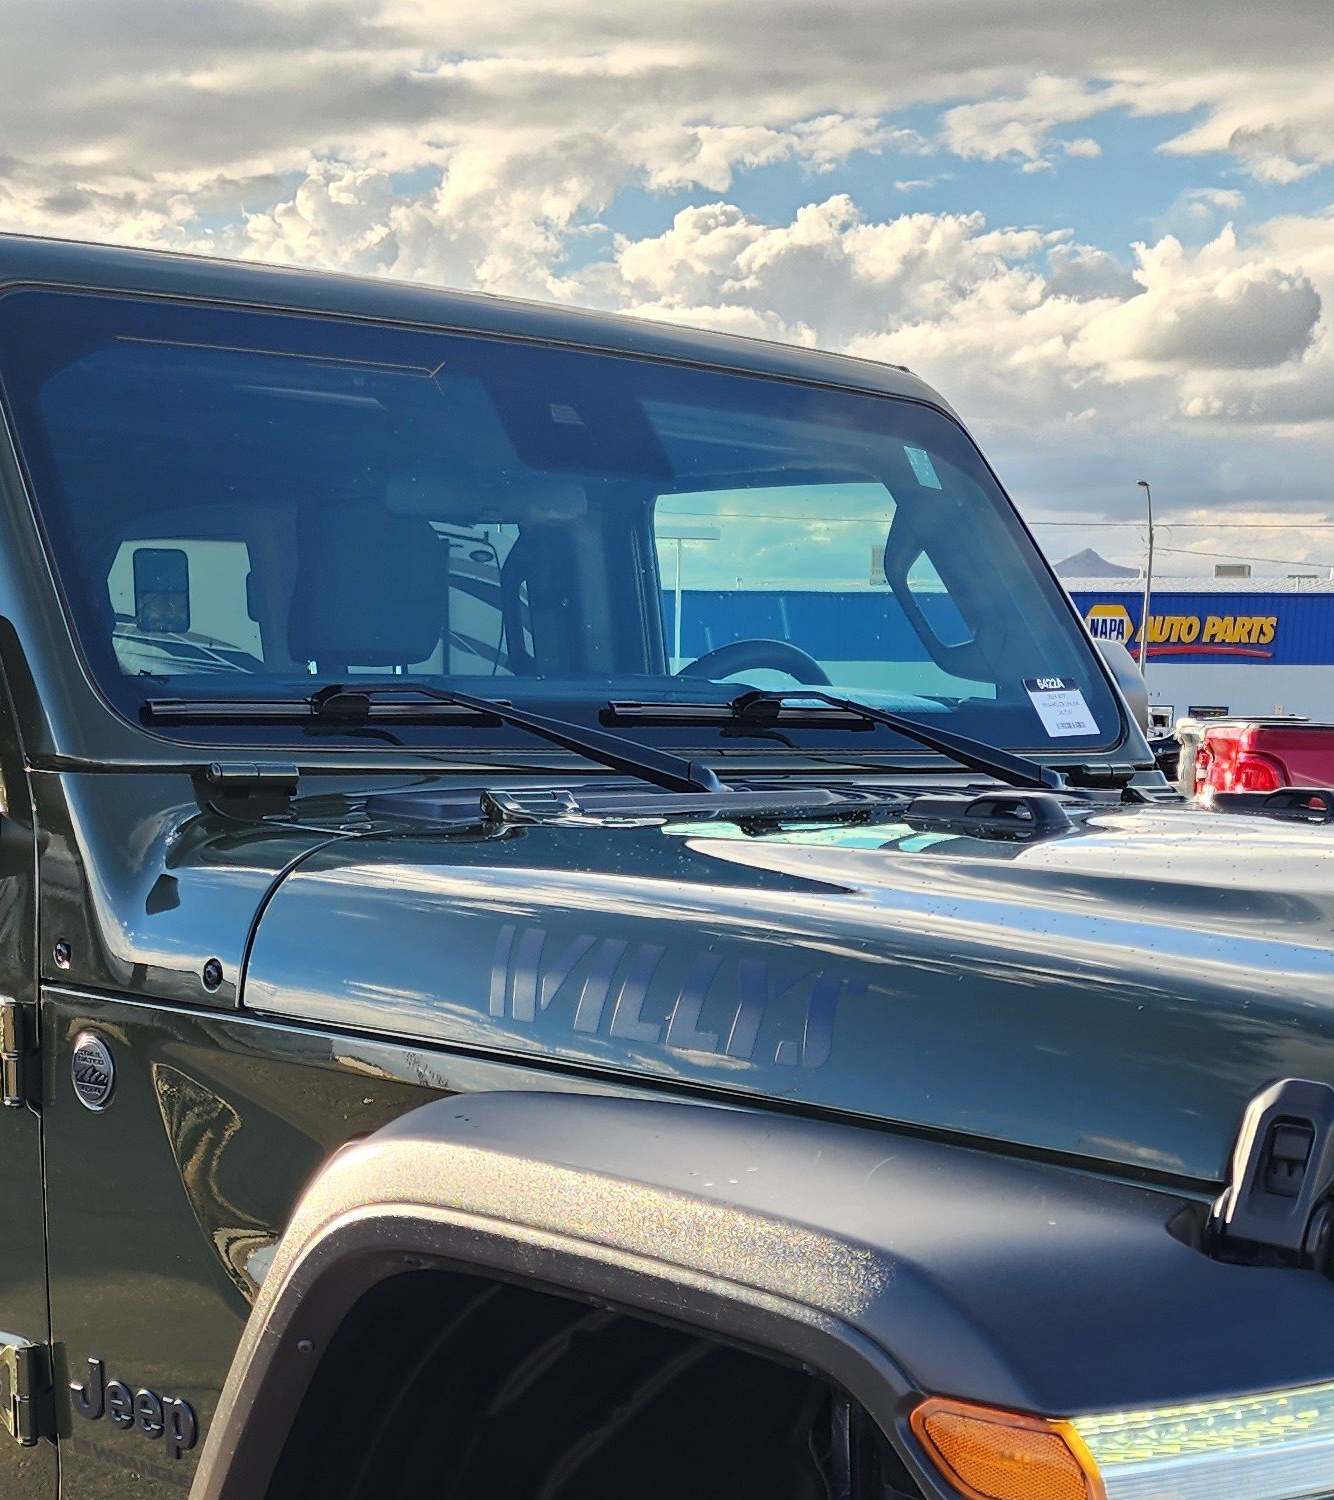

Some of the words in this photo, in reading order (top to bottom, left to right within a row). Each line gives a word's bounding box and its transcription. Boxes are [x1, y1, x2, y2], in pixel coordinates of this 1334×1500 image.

[1089, 618, 1126, 641] NAPA
[1134, 615, 1202, 645] AUTO
[1201, 615, 1279, 645] PARTS
[1036, 677, 1066, 690] 6422A
[488, 922, 869, 1071] WILLYS
[68, 1356, 197, 1461] Jeep
